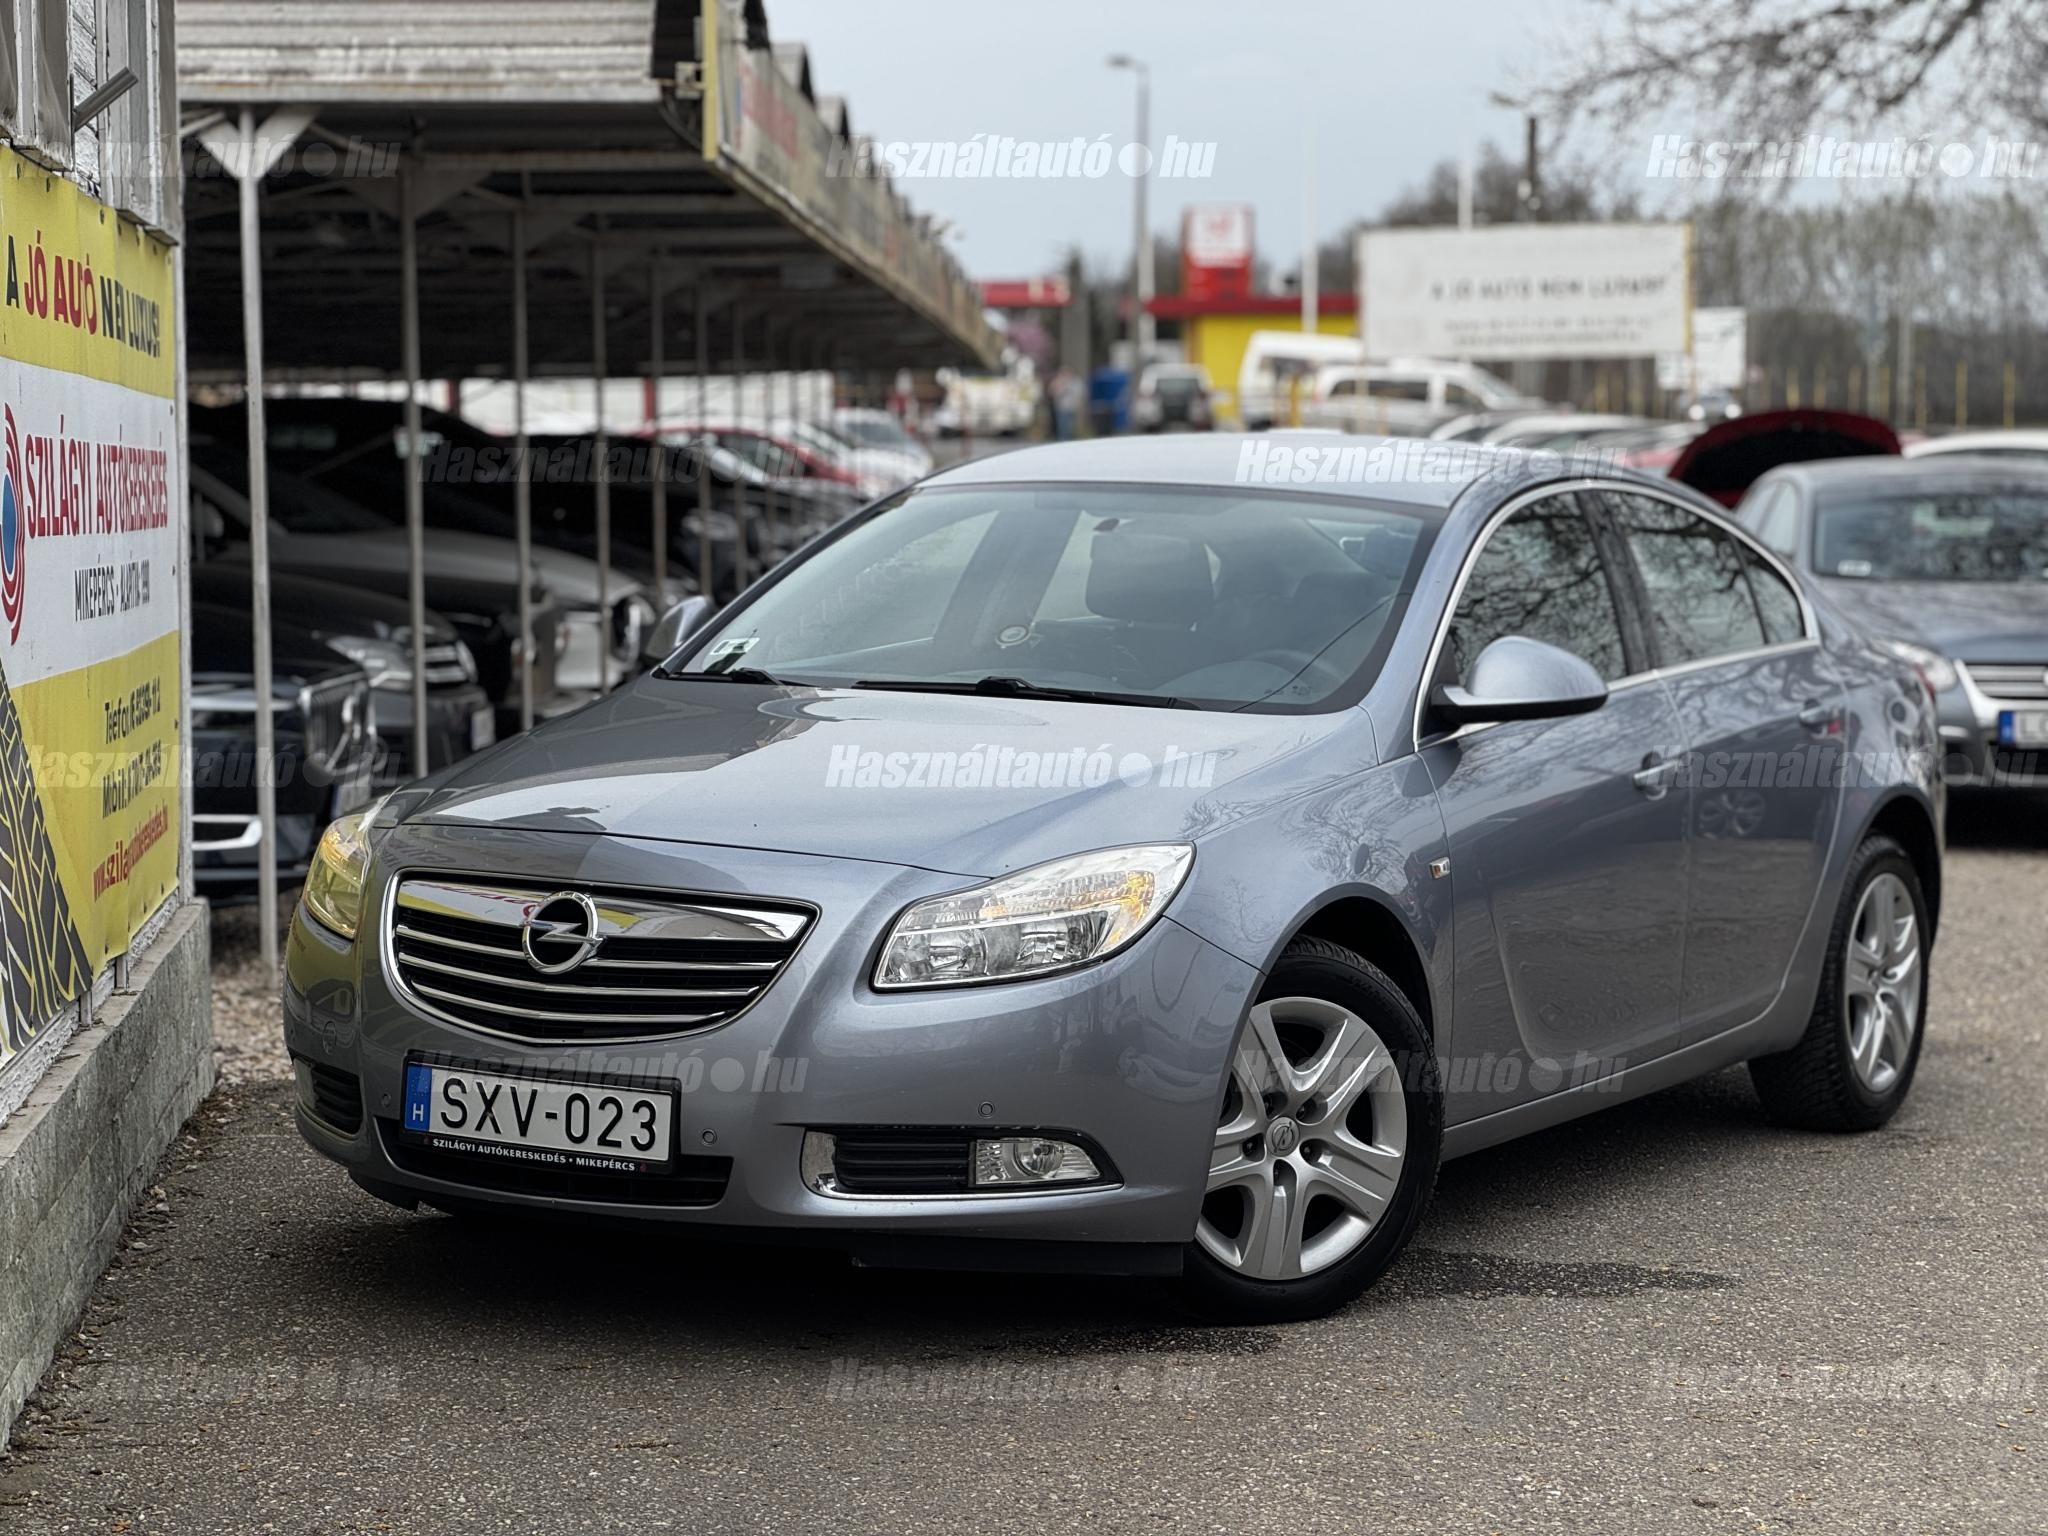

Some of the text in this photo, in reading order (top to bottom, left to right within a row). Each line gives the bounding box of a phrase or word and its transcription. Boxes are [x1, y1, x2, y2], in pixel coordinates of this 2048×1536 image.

[6, 234, 19, 309] A
[23, 229, 48, 320] JÓ
[25, 414, 93, 539] SZILÁGYI
[433, 1137, 636, 1171] SZILÁGYI AUTÓKERESKEDÉS MIKEPÉRCS
[440, 1076, 658, 1151] SXV-023
